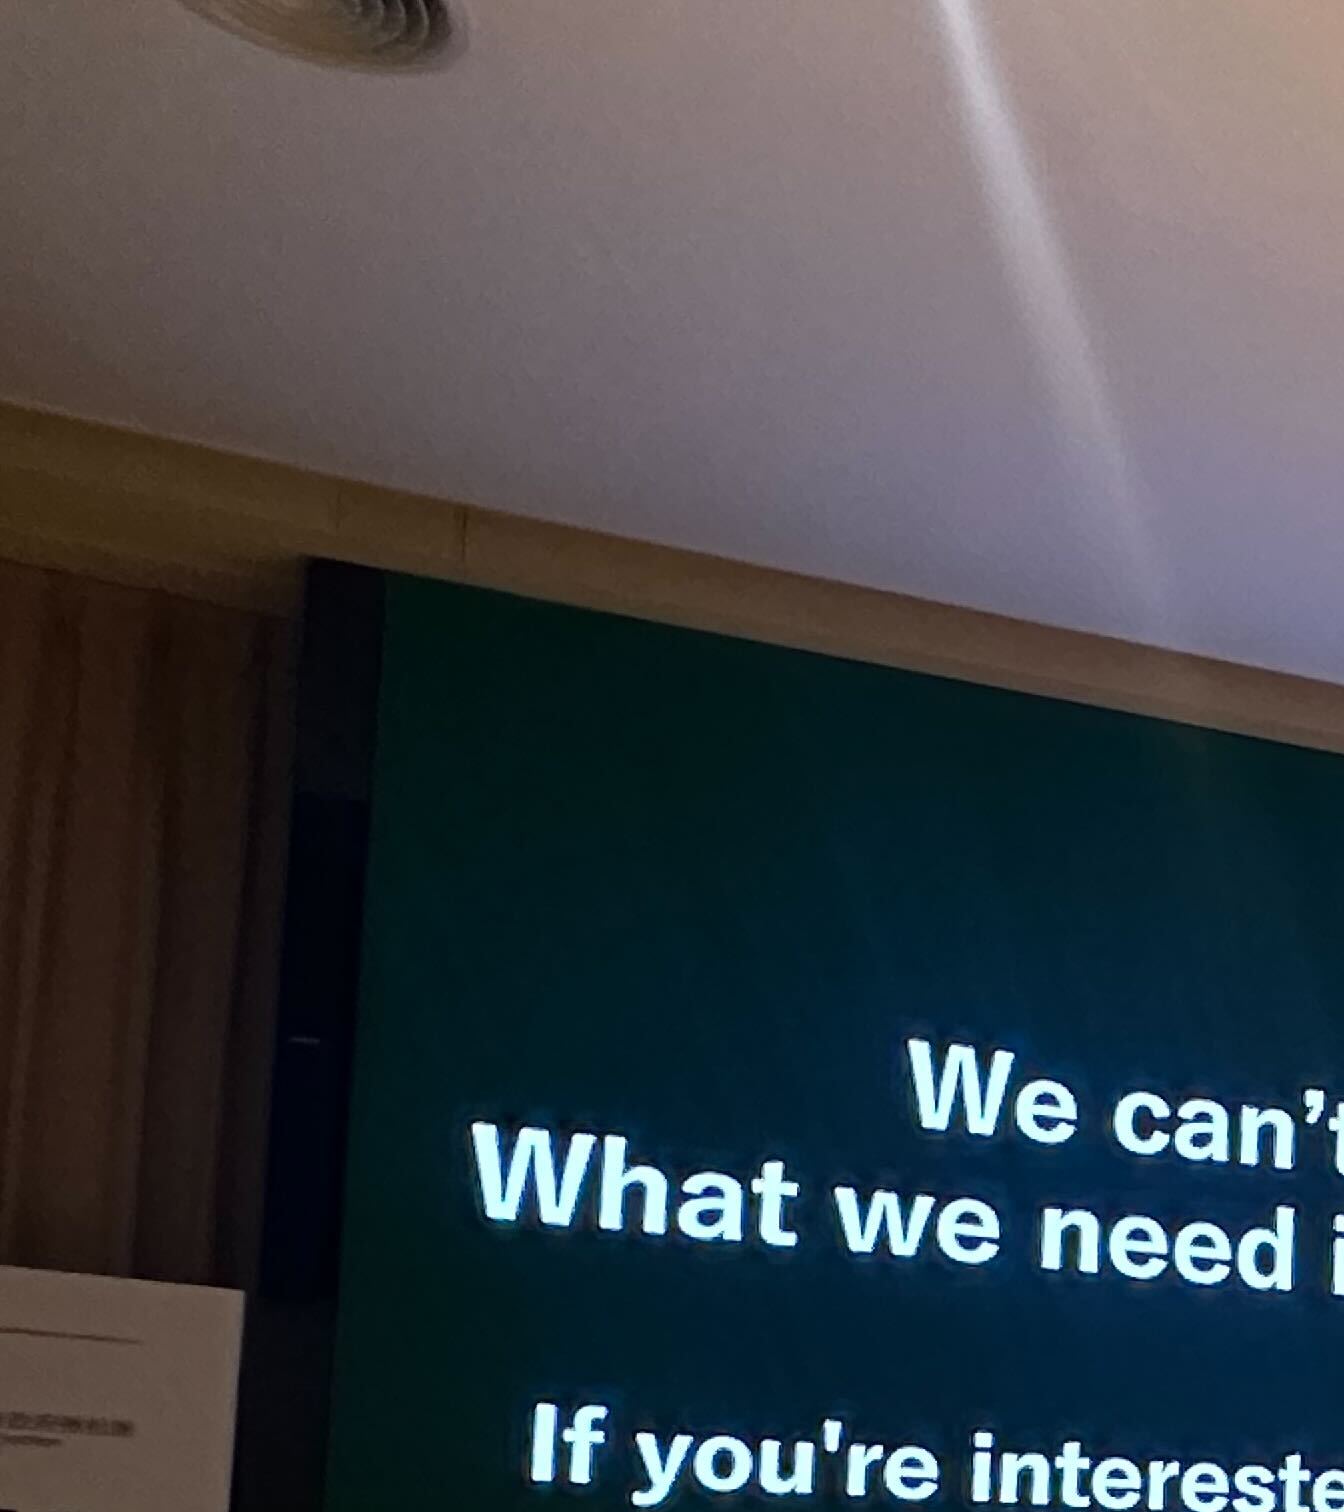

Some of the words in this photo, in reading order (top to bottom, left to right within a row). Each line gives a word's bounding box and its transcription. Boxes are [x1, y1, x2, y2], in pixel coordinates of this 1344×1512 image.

[908, 1038, 1078, 1144] We
[471, 1121, 800, 1247] What
[834, 1186, 1000, 1264] we
[1040, 1205, 1296, 1292] need
[531, 1402, 609, 1484] If
[632, 1419, 939, 1507] you're
